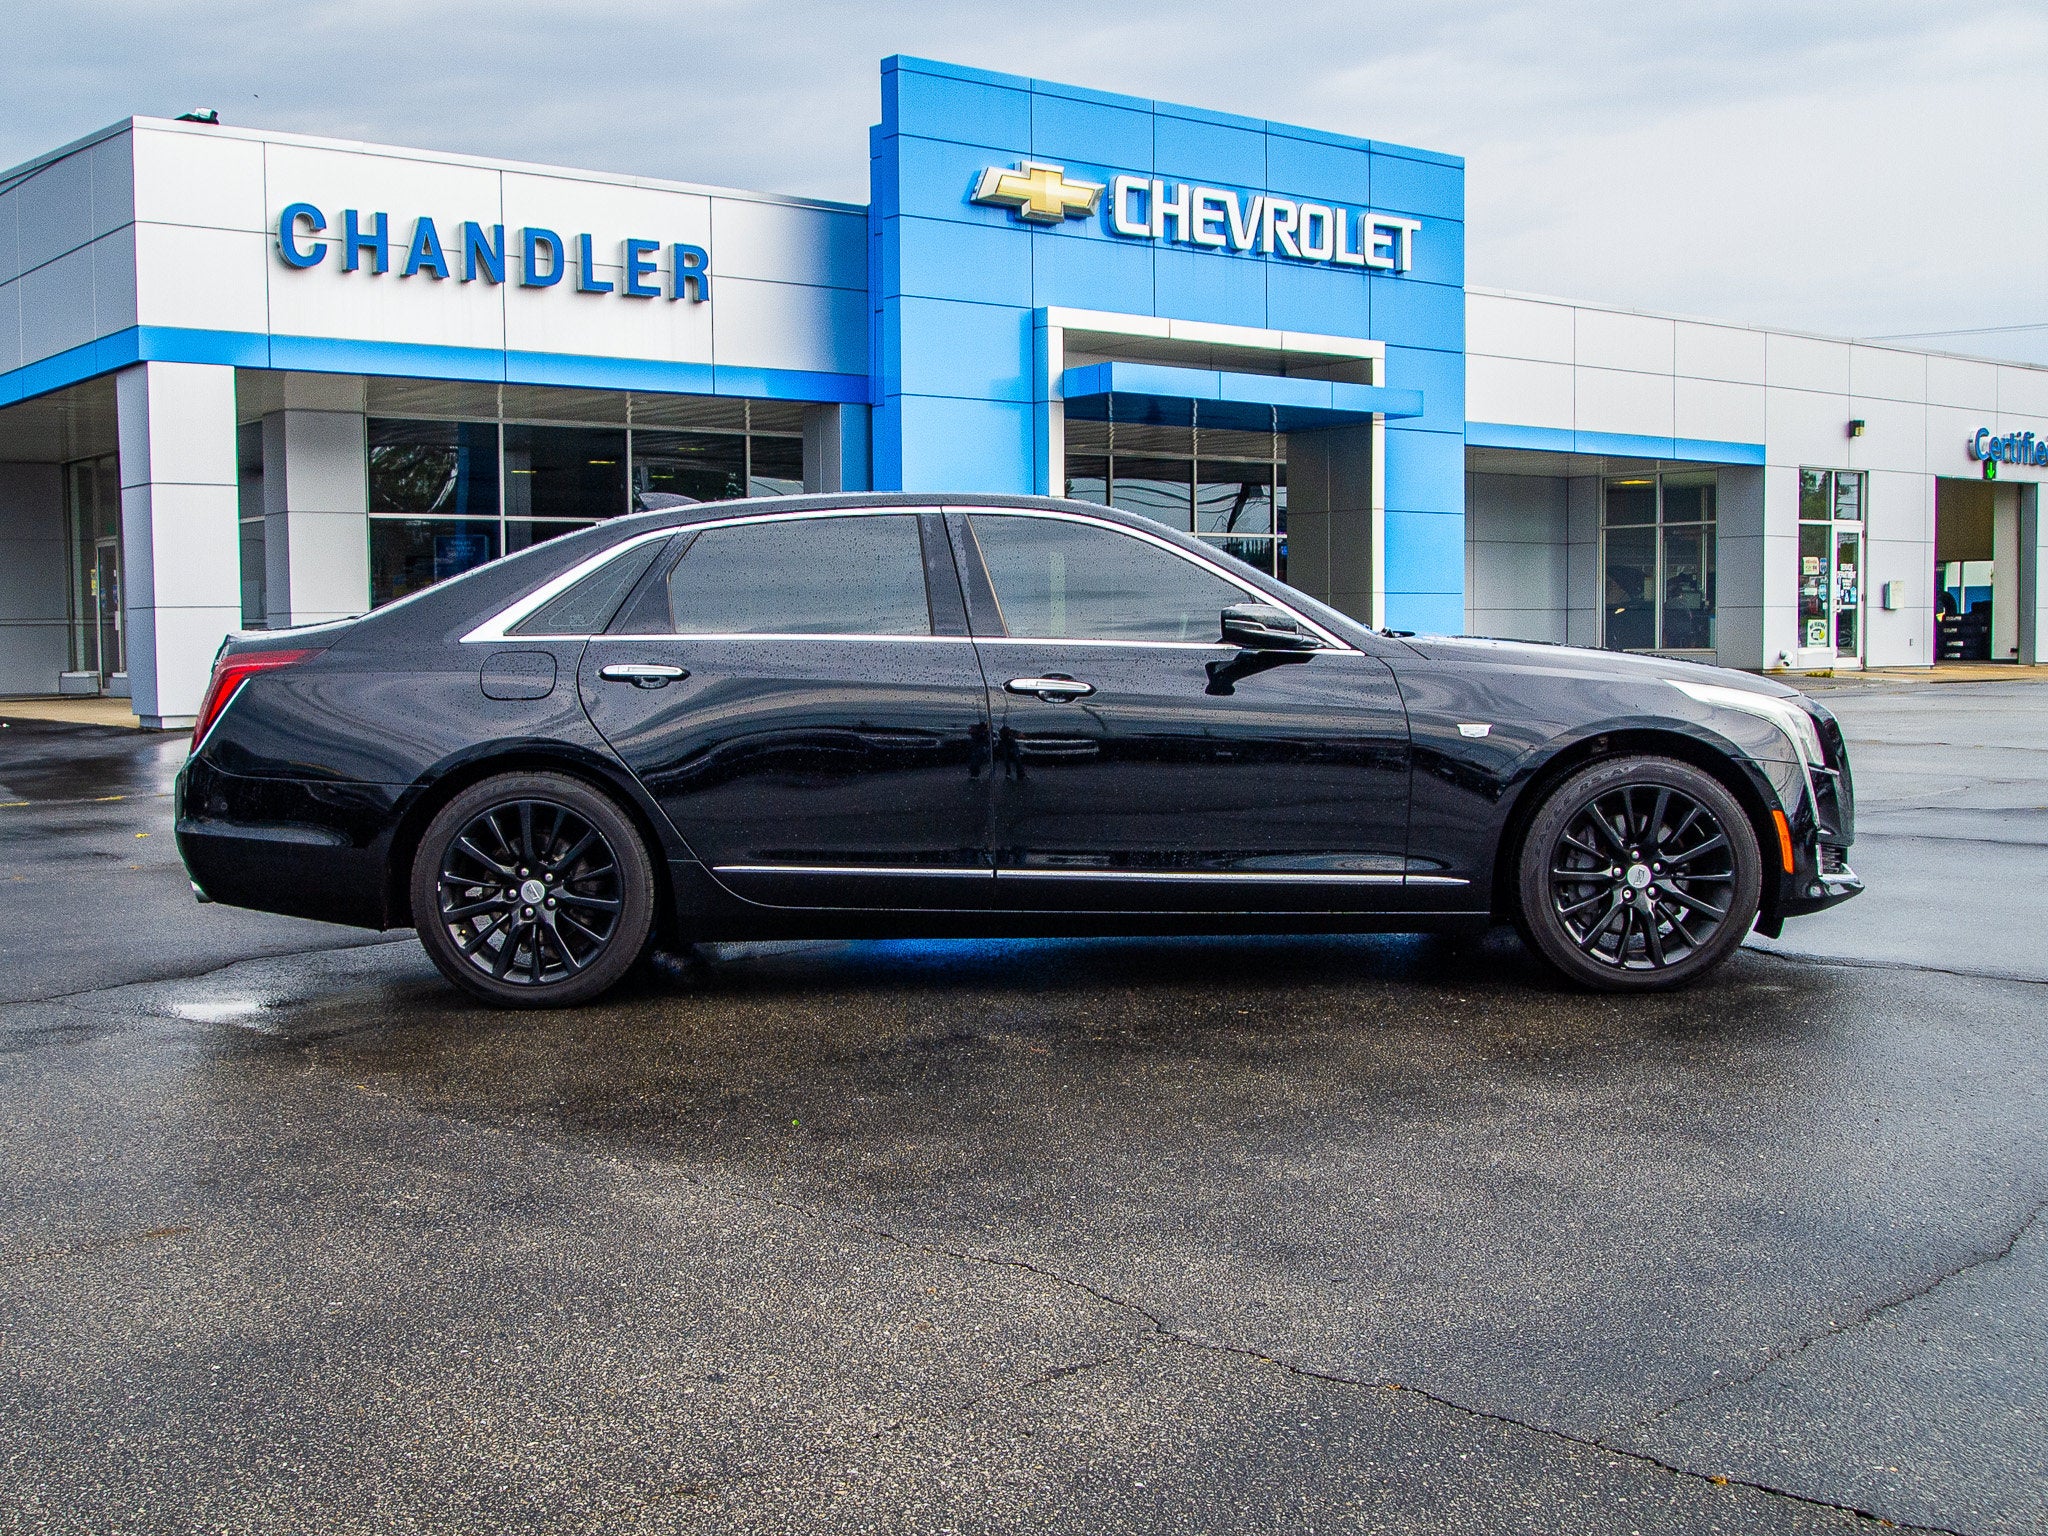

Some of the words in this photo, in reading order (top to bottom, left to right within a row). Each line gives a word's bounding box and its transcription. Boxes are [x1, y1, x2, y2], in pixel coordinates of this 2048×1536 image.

[277, 202, 710, 302] CHANDLER
[1108, 175, 1422, 273] CHEVROLET
[1970, 427, 2048, 467] Certifie
